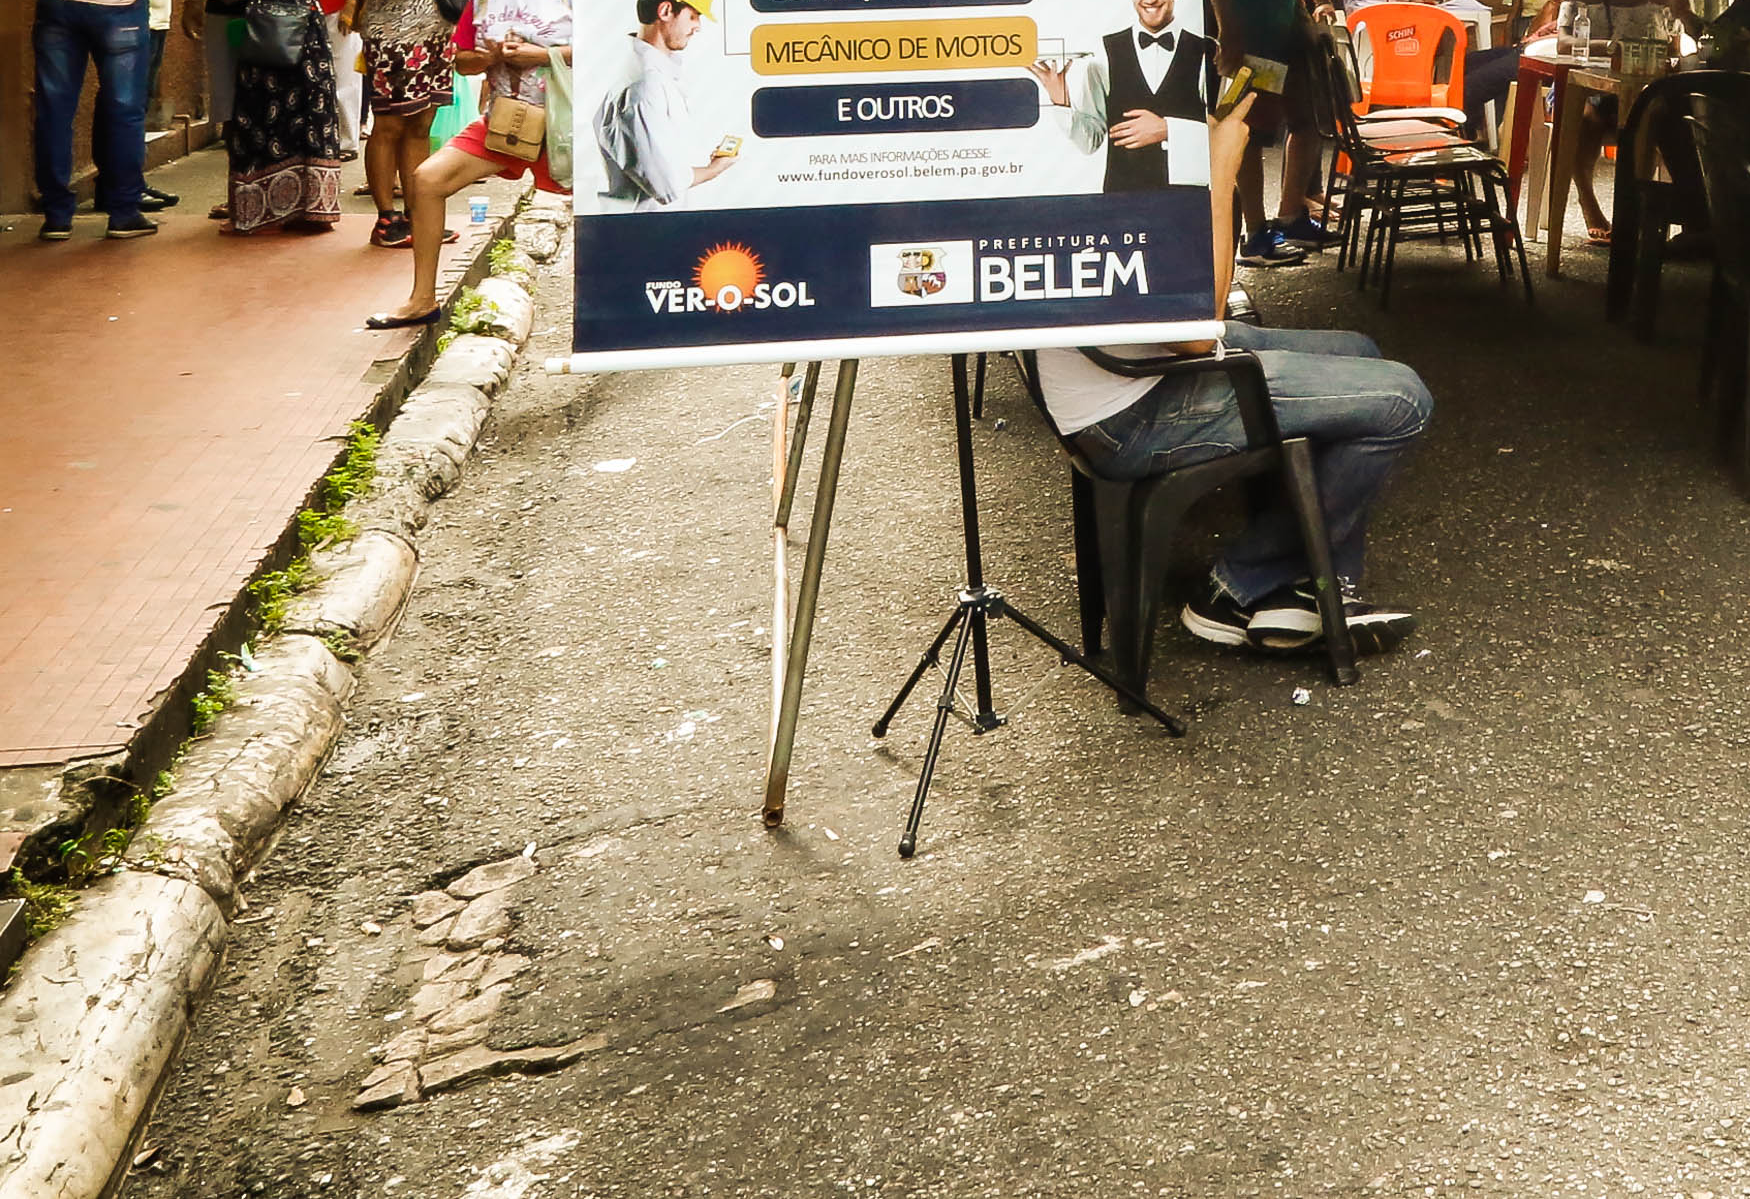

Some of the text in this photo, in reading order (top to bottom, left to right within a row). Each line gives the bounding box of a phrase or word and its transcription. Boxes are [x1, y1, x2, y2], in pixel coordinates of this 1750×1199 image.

[765, 34, 1023, 63] MECÂNICO DE MOTOS
[838, 95, 954, 121] E OUTROS
[809, 153, 837, 165] PARA
[840, 152, 868, 164] MAIS
[869, 148, 950, 163] INFORMAÇÕES
[777, 162, 1024, 182] www.fundoverosol.belem.pa.gov.br
[979, 233, 1148, 250] PREFEITURA DE
[646, 281, 682, 290] FUNDO
[980, 247, 1150, 302] BELÉM
[645, 281, 816, 314] VER-O-SOL
